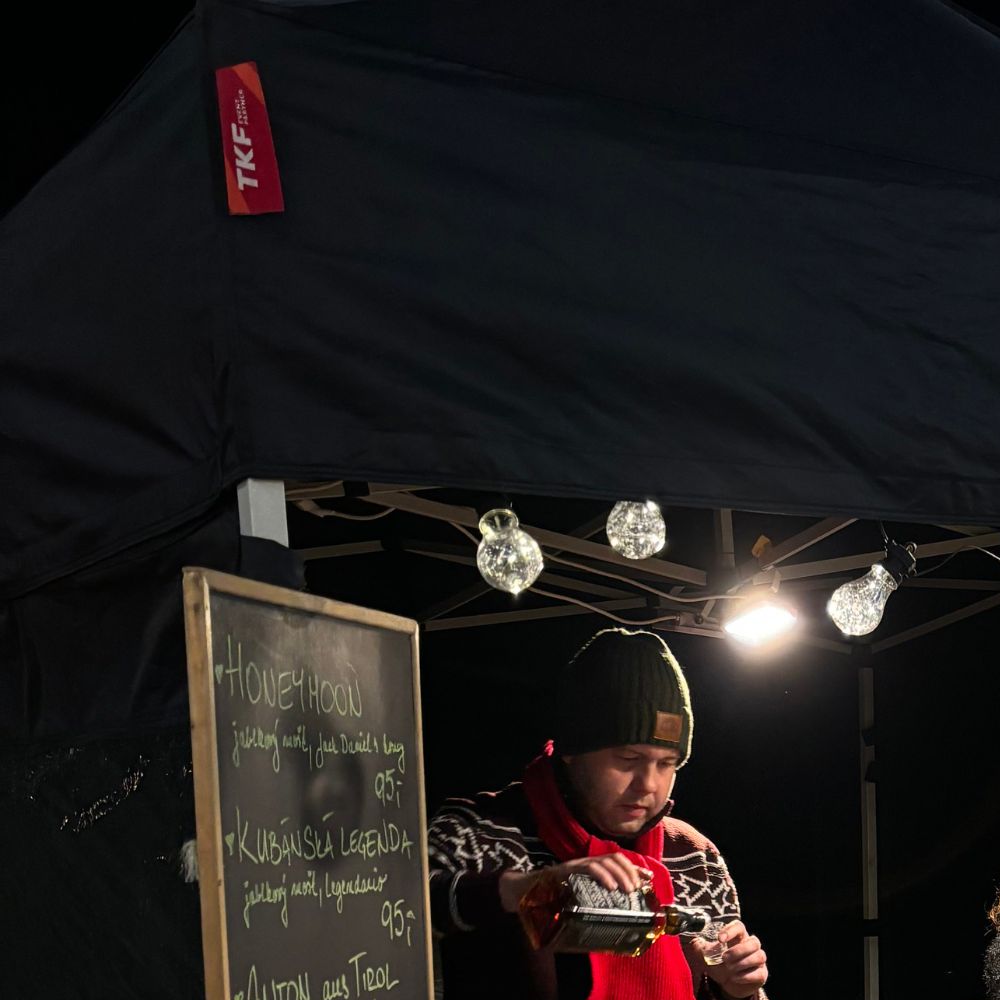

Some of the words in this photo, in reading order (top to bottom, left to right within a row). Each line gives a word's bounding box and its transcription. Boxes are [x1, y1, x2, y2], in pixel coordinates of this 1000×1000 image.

[230, 122, 259, 191] TKF
[225, 633, 362, 718] HONEYMOON
[235, 805, 334, 867] KUBÁNSKÁ
[340, 818, 414, 861] LEGENDA
[243, 874, 289, 929] jablkový
[349, 951, 399, 999] TIROL
